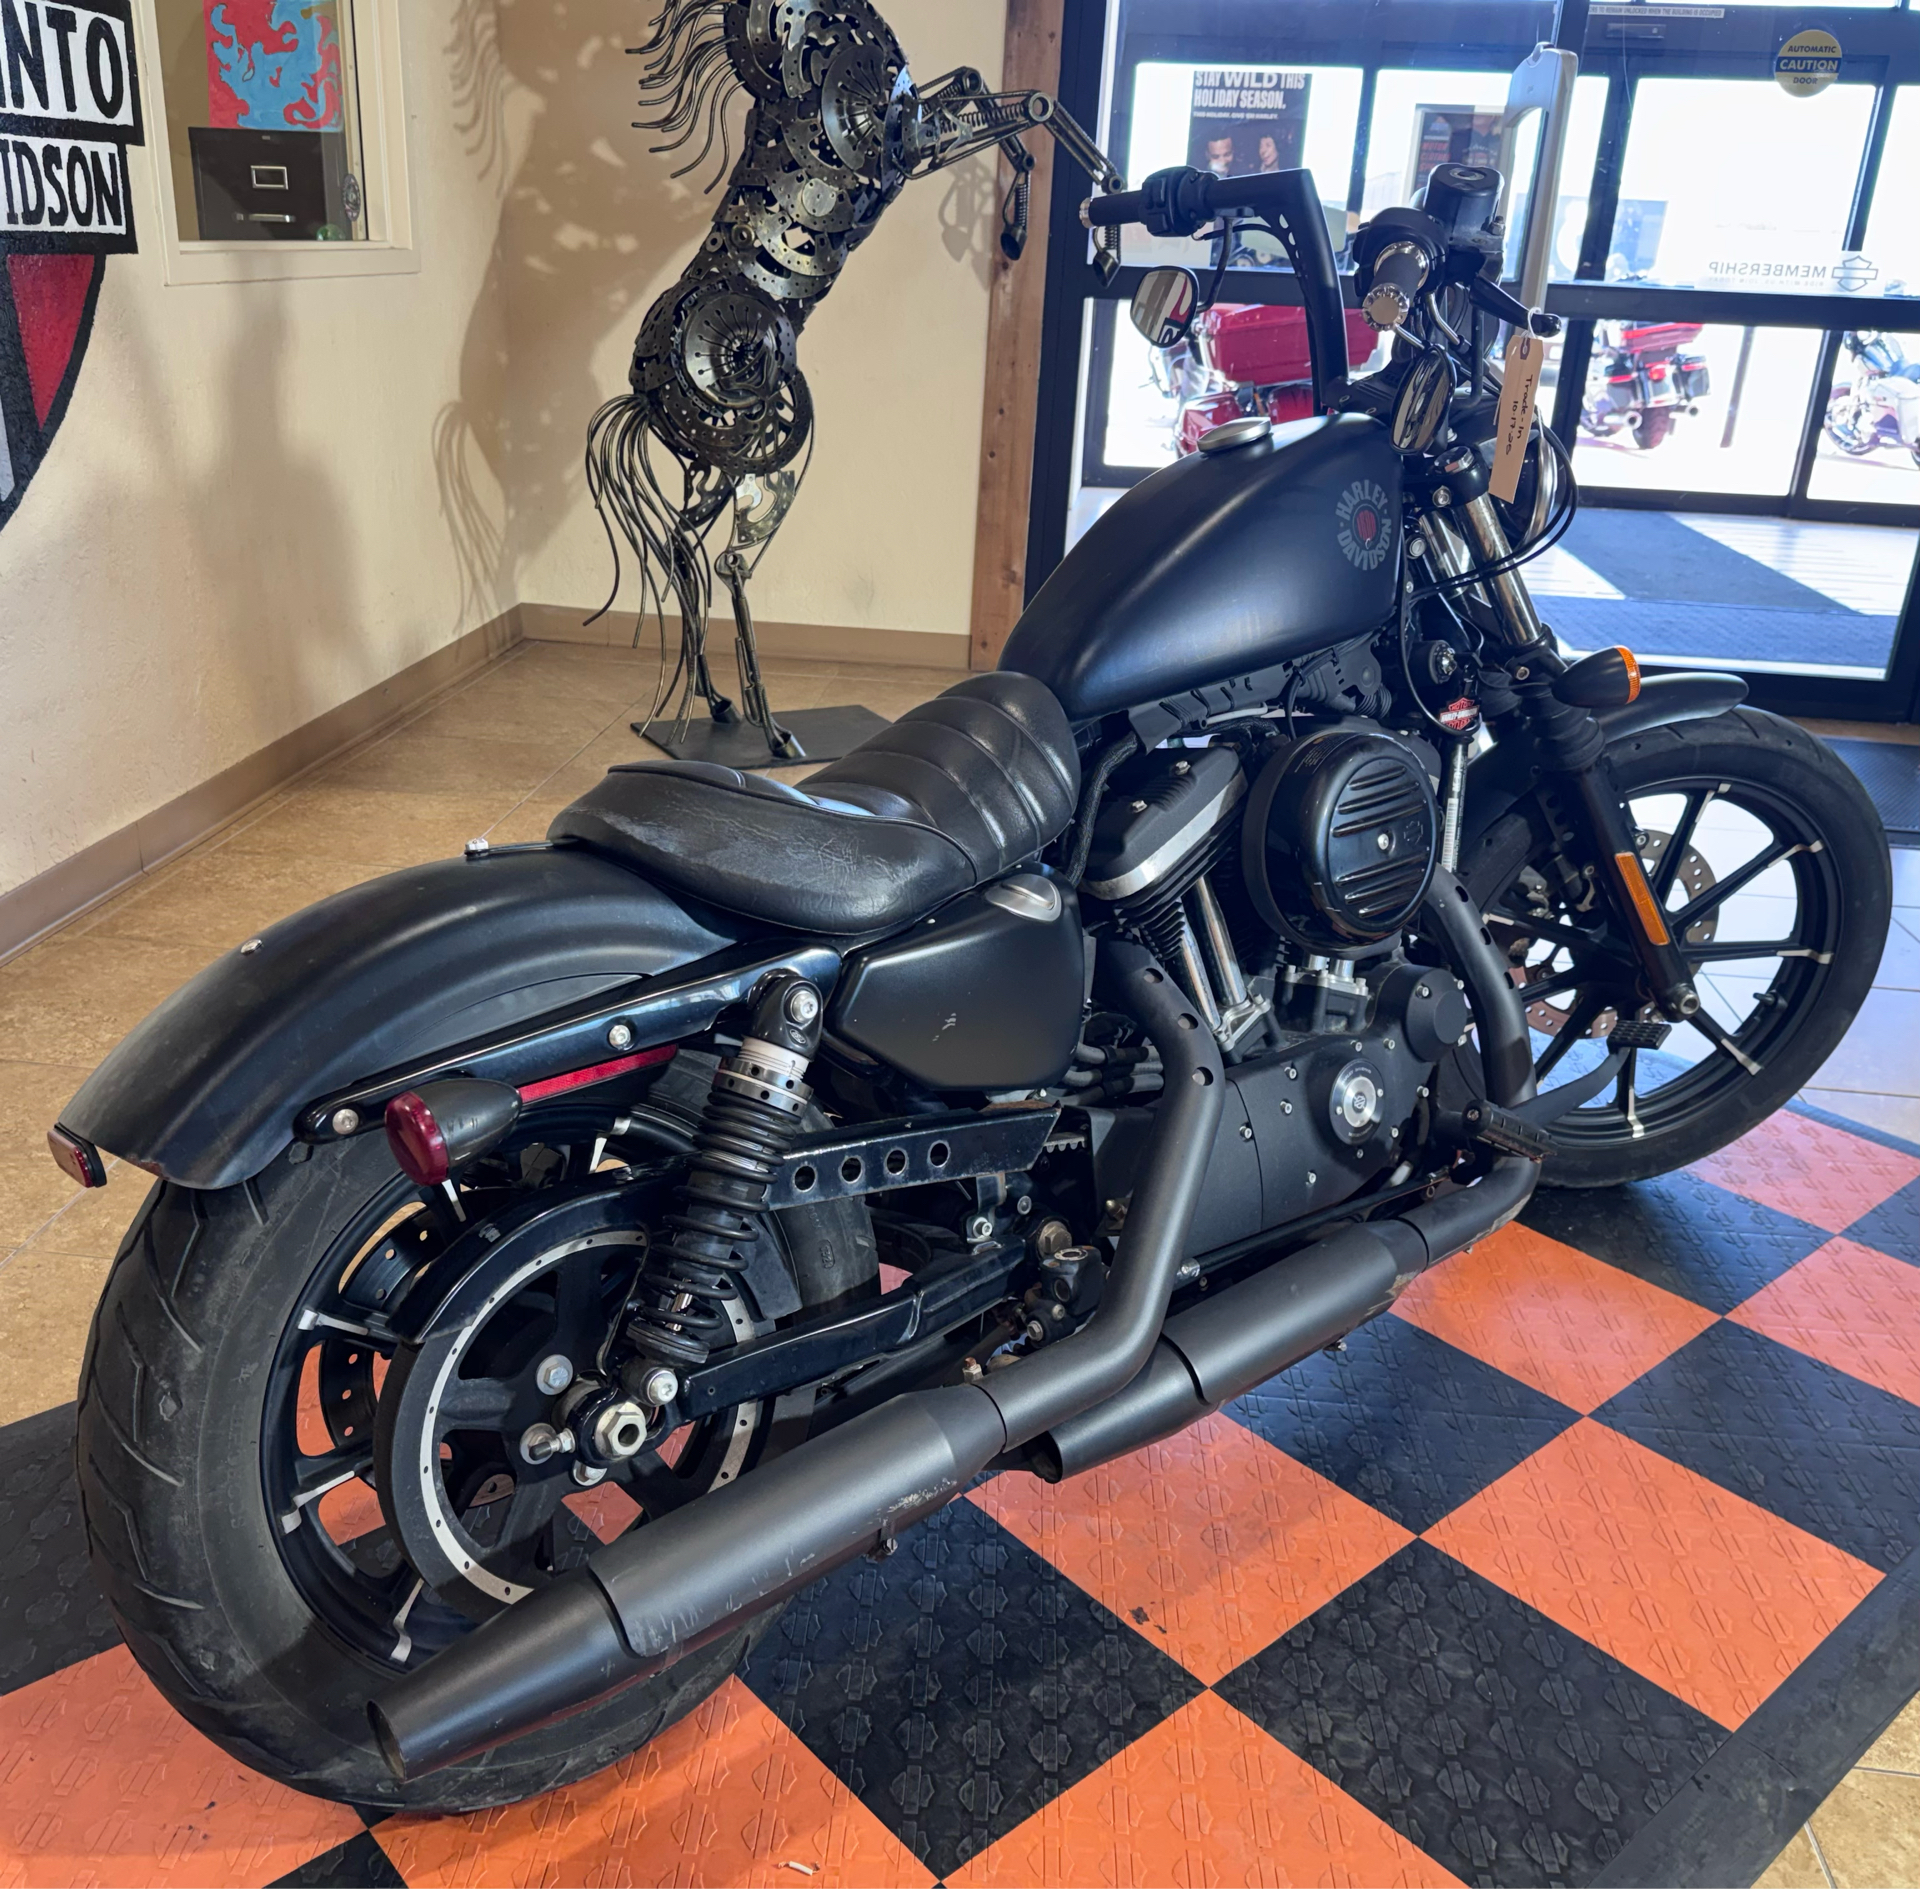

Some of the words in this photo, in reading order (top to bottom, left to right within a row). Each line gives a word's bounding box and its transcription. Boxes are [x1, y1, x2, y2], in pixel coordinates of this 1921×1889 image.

[1624, 7, 1648, 16] UNLOCKED
[1648, 8, 1661, 16] WHEN
[1662, 8, 1671, 16] THE
[1672, 8, 1693, 17] BUILDING
[1699, 9, 1722, 17] OCCUPIED
[1788, 45, 1836, 53] AUTOMATIC
[0, 0, 124, 118] NTO
[1780, 59, 1838, 71] CAUTION
[1195, 72, 1221, 87] STAY
[1224, 72, 1278, 89] WILD
[1280, 74, 1305, 90] THIS
[1194, 89, 1239, 108] HOLIDAY
[1240, 91, 1286, 109] SEASON.
[1335, 479, 1388, 521] HARLEY
[1337, 518, 1392, 571] DAVIDSON
